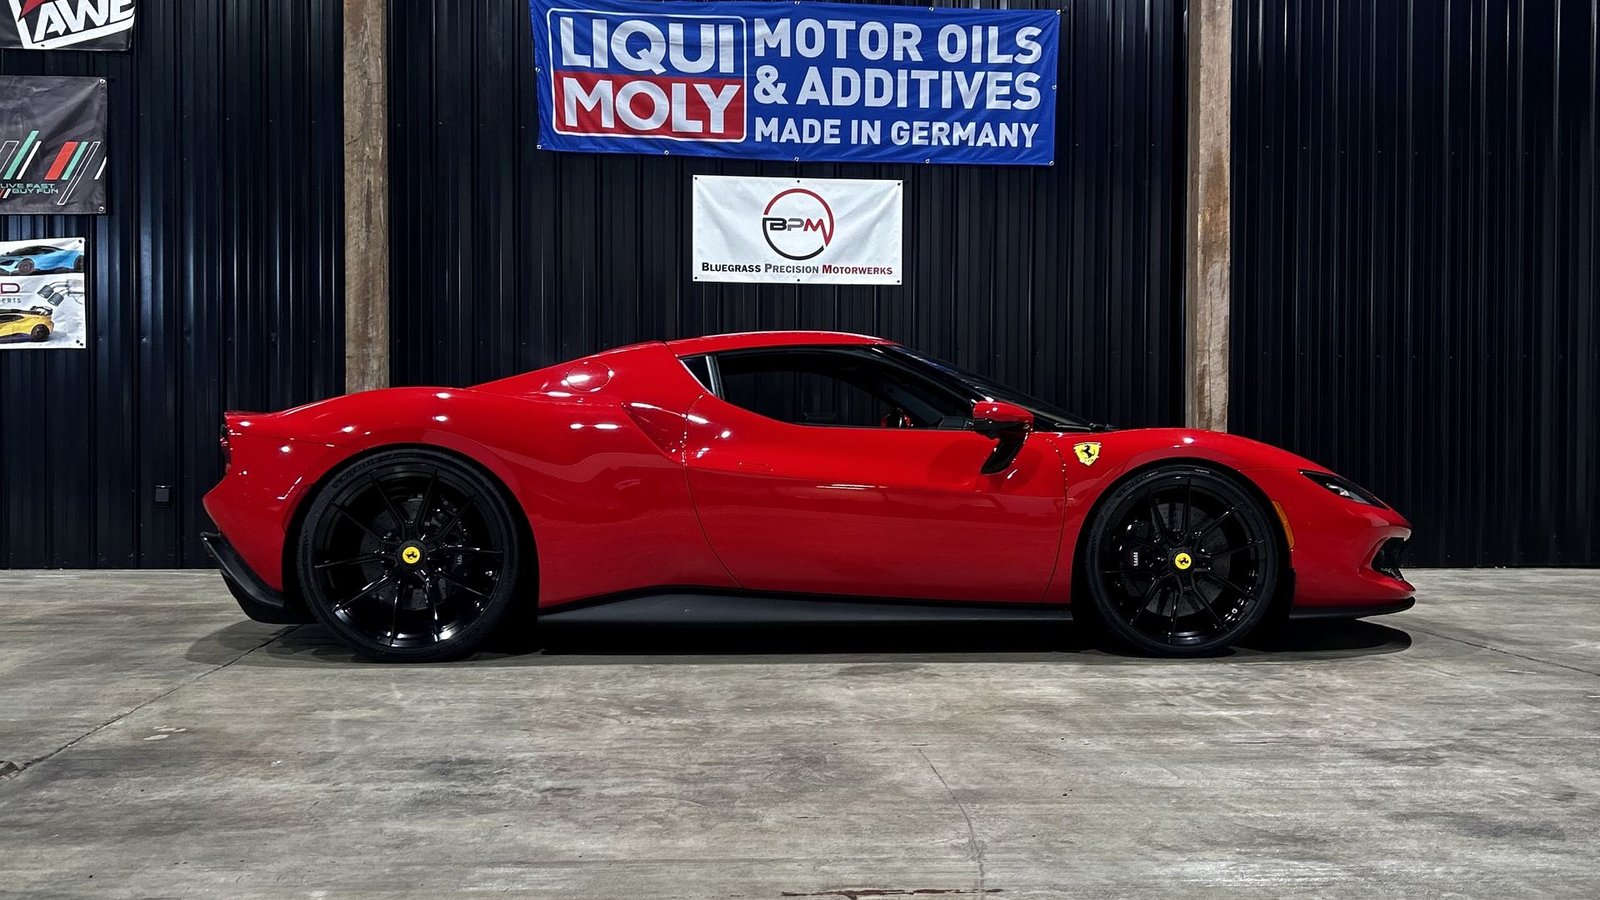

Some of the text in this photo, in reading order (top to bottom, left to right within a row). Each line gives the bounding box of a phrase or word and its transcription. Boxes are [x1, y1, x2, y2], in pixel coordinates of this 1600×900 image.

[33, 0, 135, 42] AWE
[754, 18, 1042, 64] MOTOR OILS
[559, 16, 734, 75] LIQUI
[562, 76, 741, 134] MOLY
[753, 64, 1041, 110] & ADDITIVES
[755, 116, 1039, 148] MADE IN GERMANY
[762, 217, 824, 232] BPM
